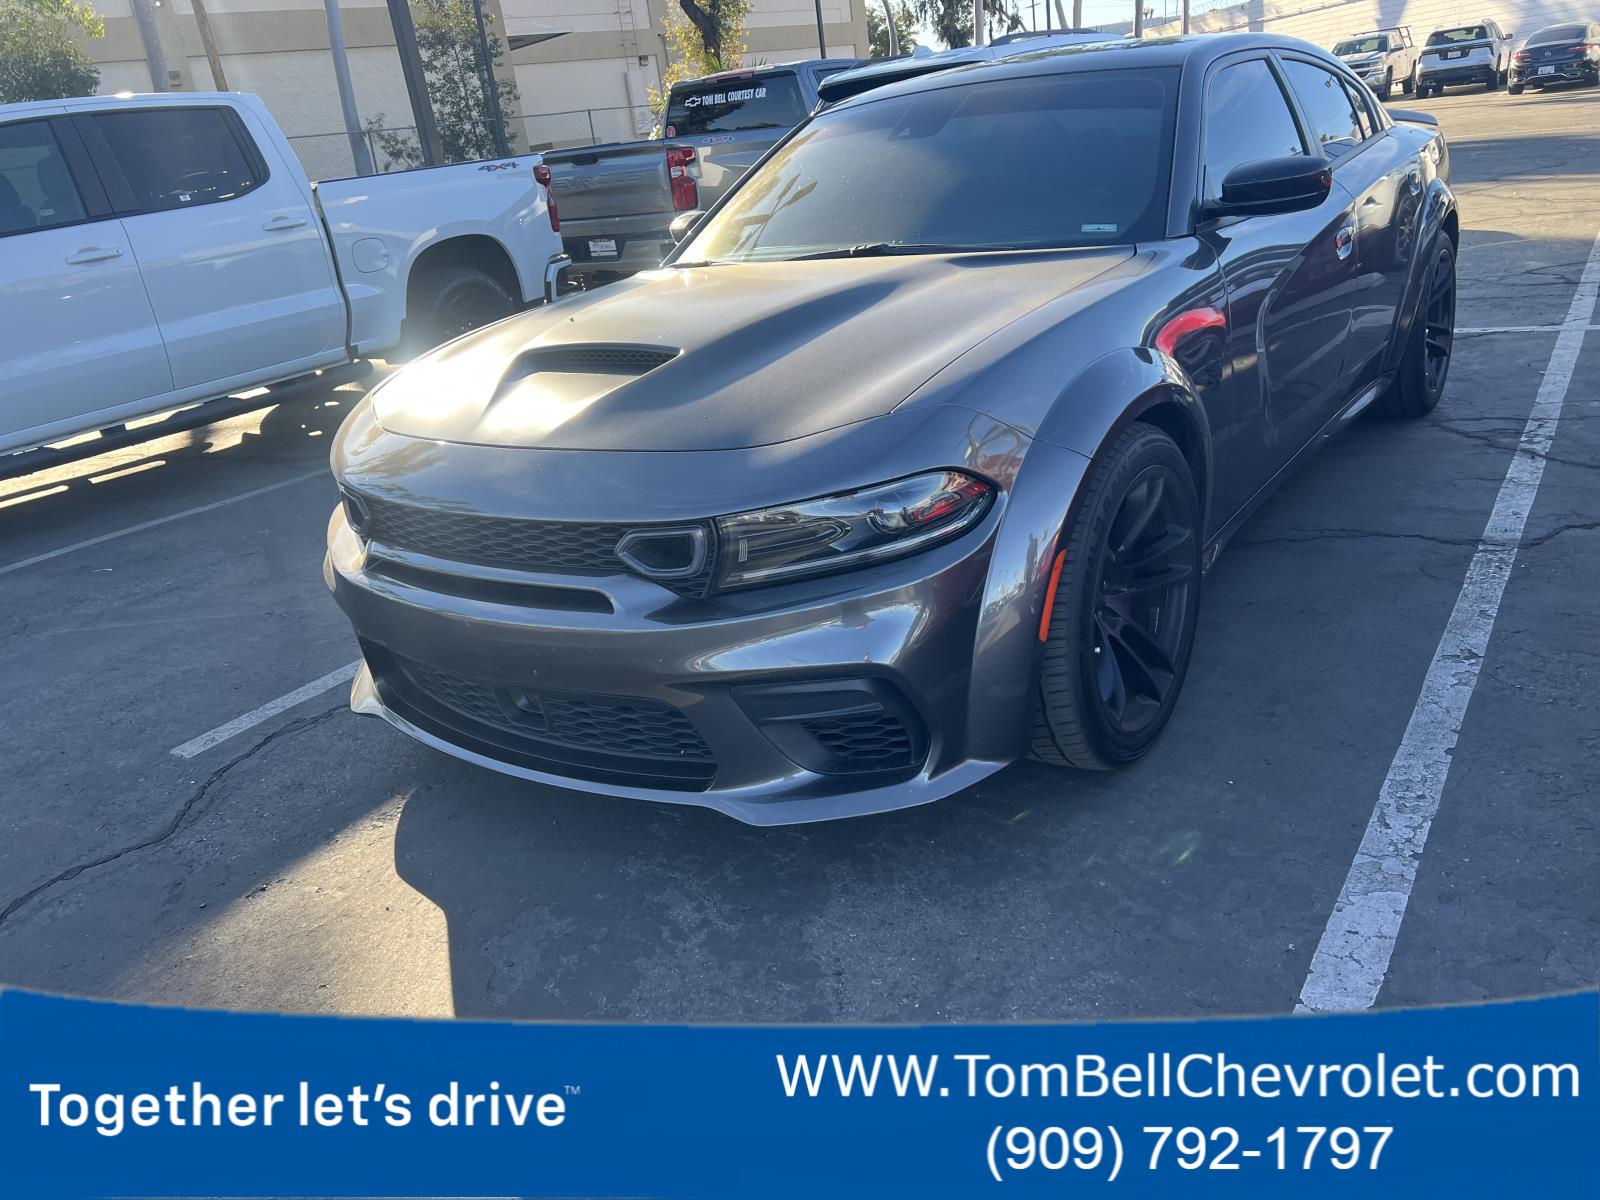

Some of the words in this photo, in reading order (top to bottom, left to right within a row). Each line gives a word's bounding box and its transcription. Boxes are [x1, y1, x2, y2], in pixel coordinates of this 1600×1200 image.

[702, 95, 714, 106] TOM
[714, 93, 726, 104] BELL
[727, 88, 754, 101] COURTESY
[755, 88, 767, 98] CAR
